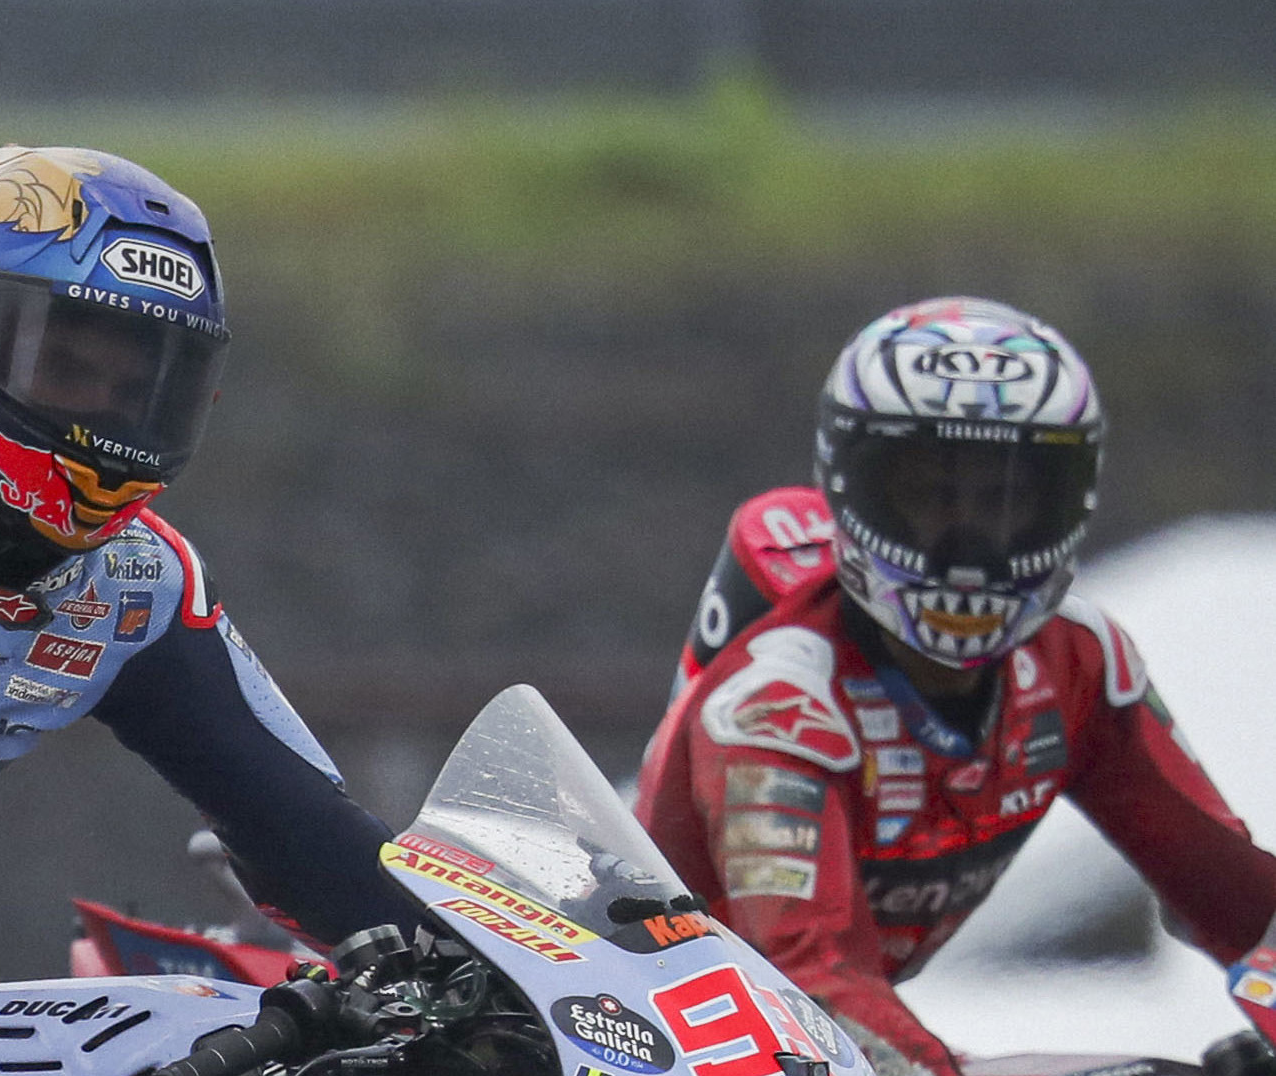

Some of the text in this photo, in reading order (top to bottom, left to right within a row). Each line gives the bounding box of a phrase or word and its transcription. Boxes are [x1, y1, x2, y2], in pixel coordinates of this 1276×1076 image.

[121, 248, 193, 291] SHOEI
[68, 284, 130, 309] GIVES
[141, 301, 177, 322] YOU
[93, 435, 161, 467] VERTICAL
[386, 851, 580, 940] Antangin
[571, 1004, 654, 1046] Estrella
[574, 1021, 653, 1062] Galicia
